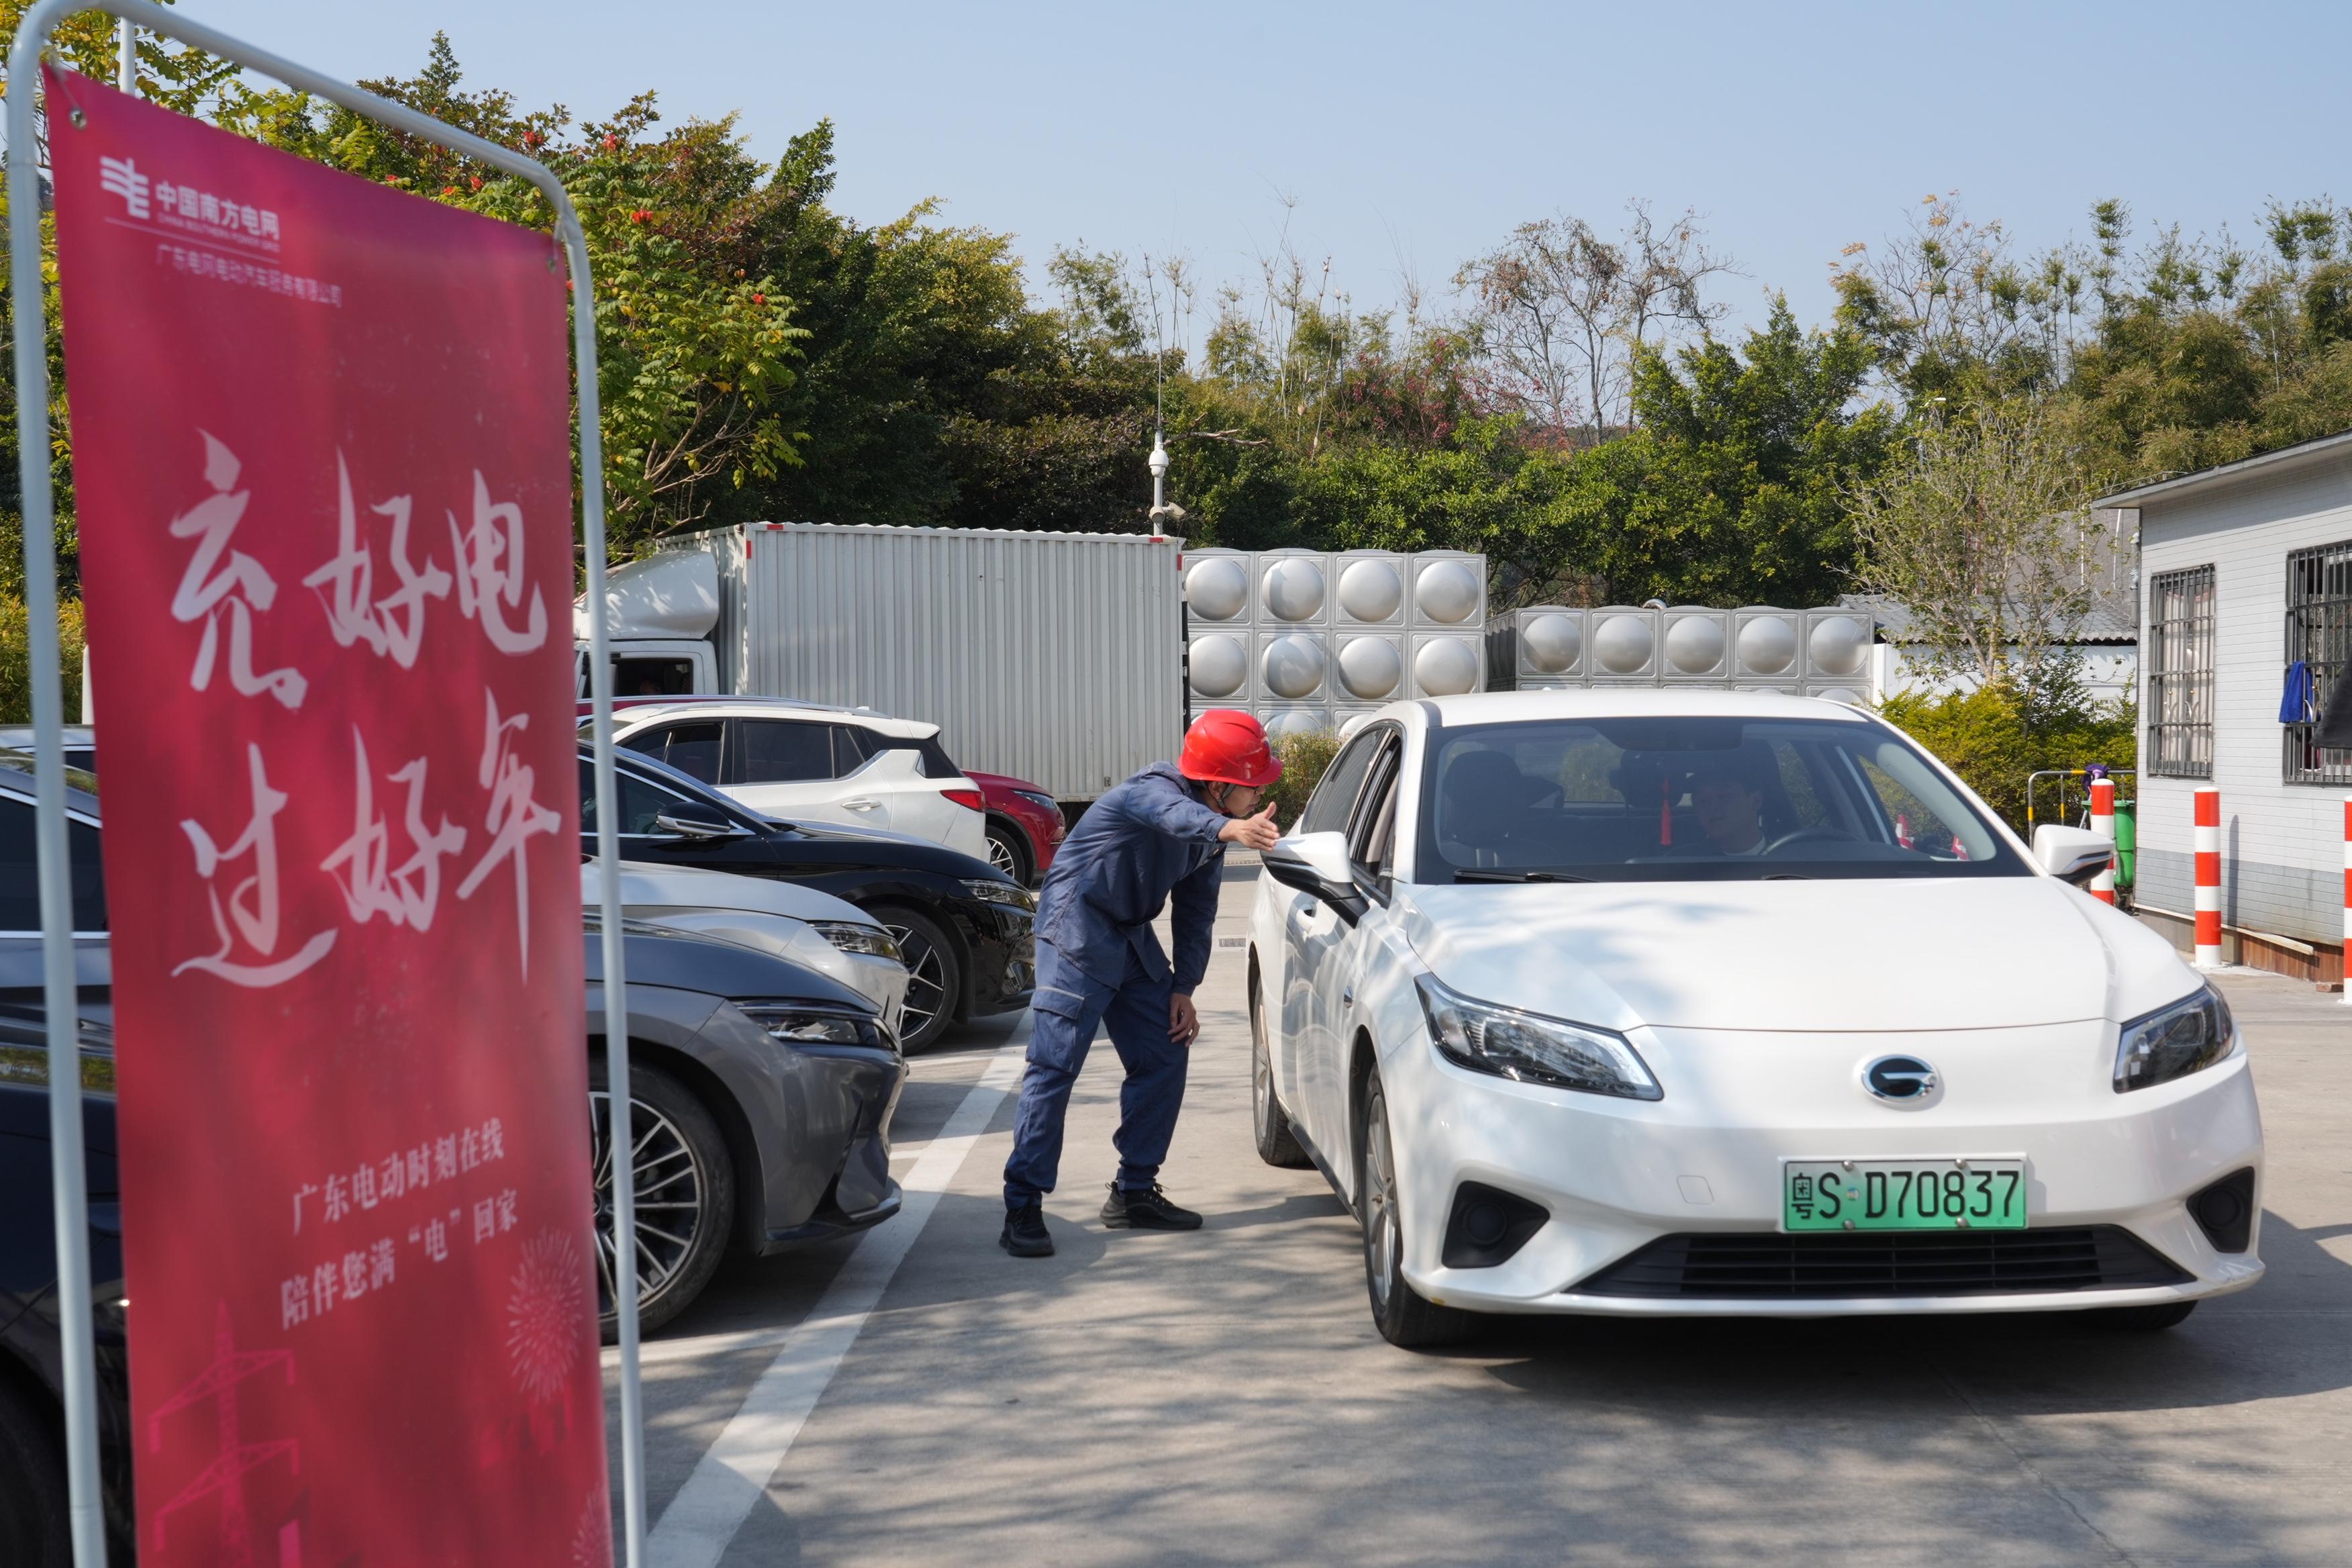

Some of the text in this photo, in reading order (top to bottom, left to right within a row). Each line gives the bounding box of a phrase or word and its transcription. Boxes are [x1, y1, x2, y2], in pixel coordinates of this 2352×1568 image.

[156, 181, 279, 240] 中国南方电网
[169, 428, 548, 709] 充好电
[170, 686, 561, 987] 过好年
[293, 1117, 504, 1235] 广东电动时刻在线
